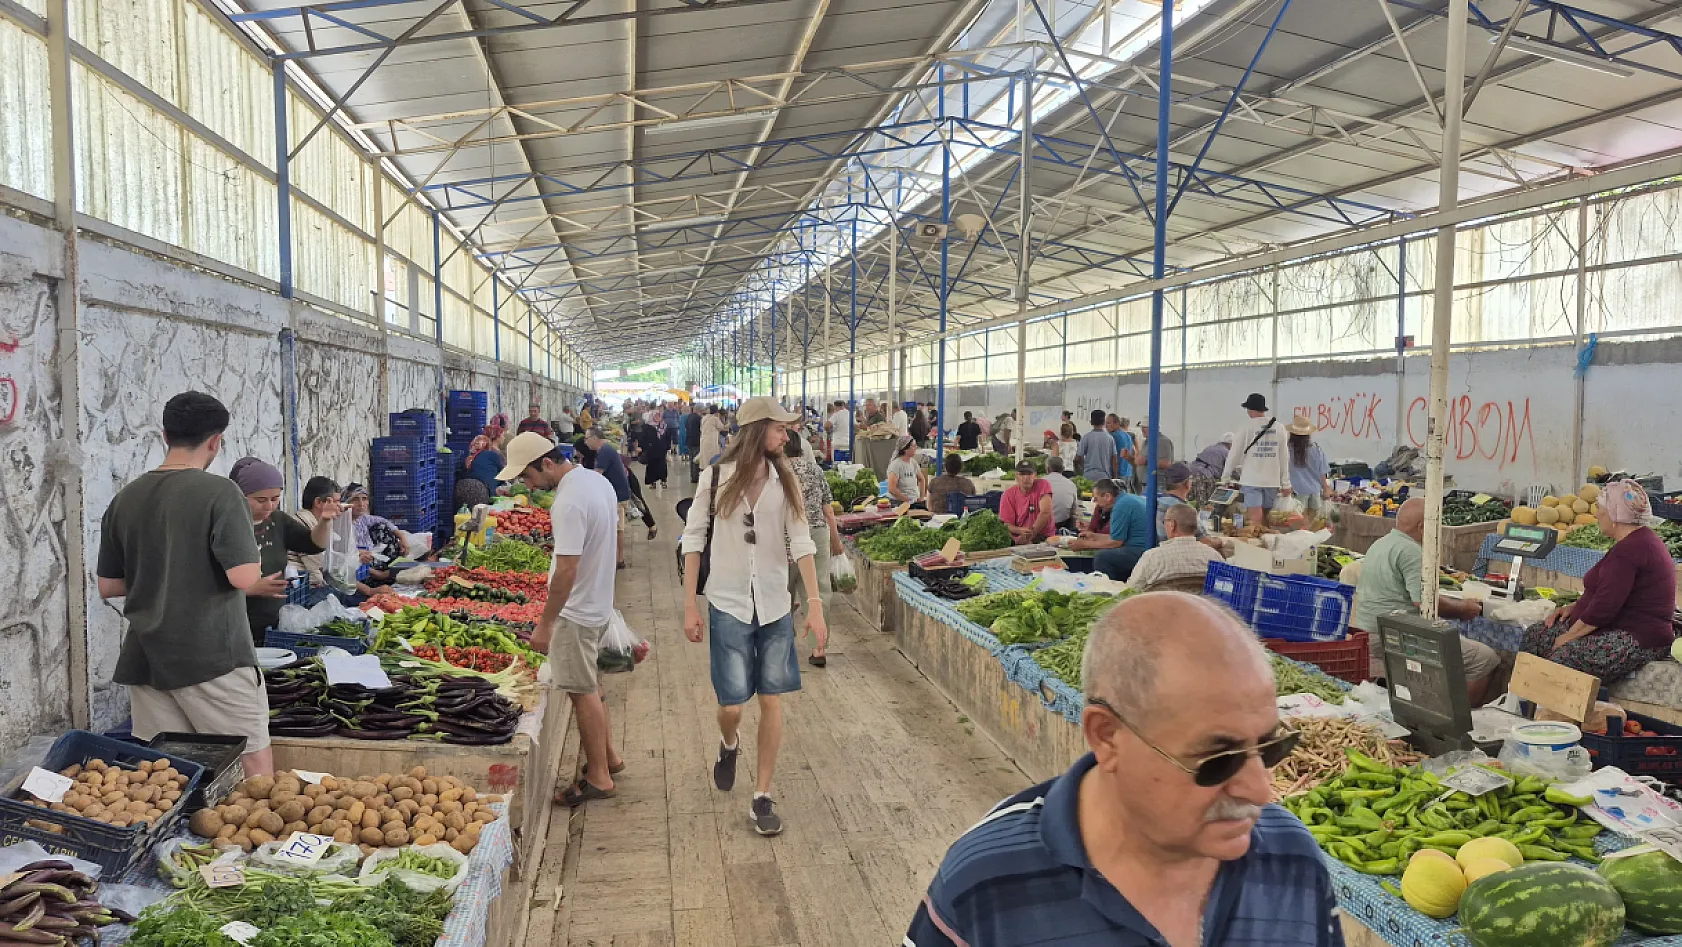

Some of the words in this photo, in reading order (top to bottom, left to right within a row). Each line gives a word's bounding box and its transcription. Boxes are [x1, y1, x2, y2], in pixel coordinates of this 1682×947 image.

[1316, 393, 1382, 440] BÜYÜK
[1407, 394, 1537, 474] CMBOM
[286, 833, 322, 860] 170
